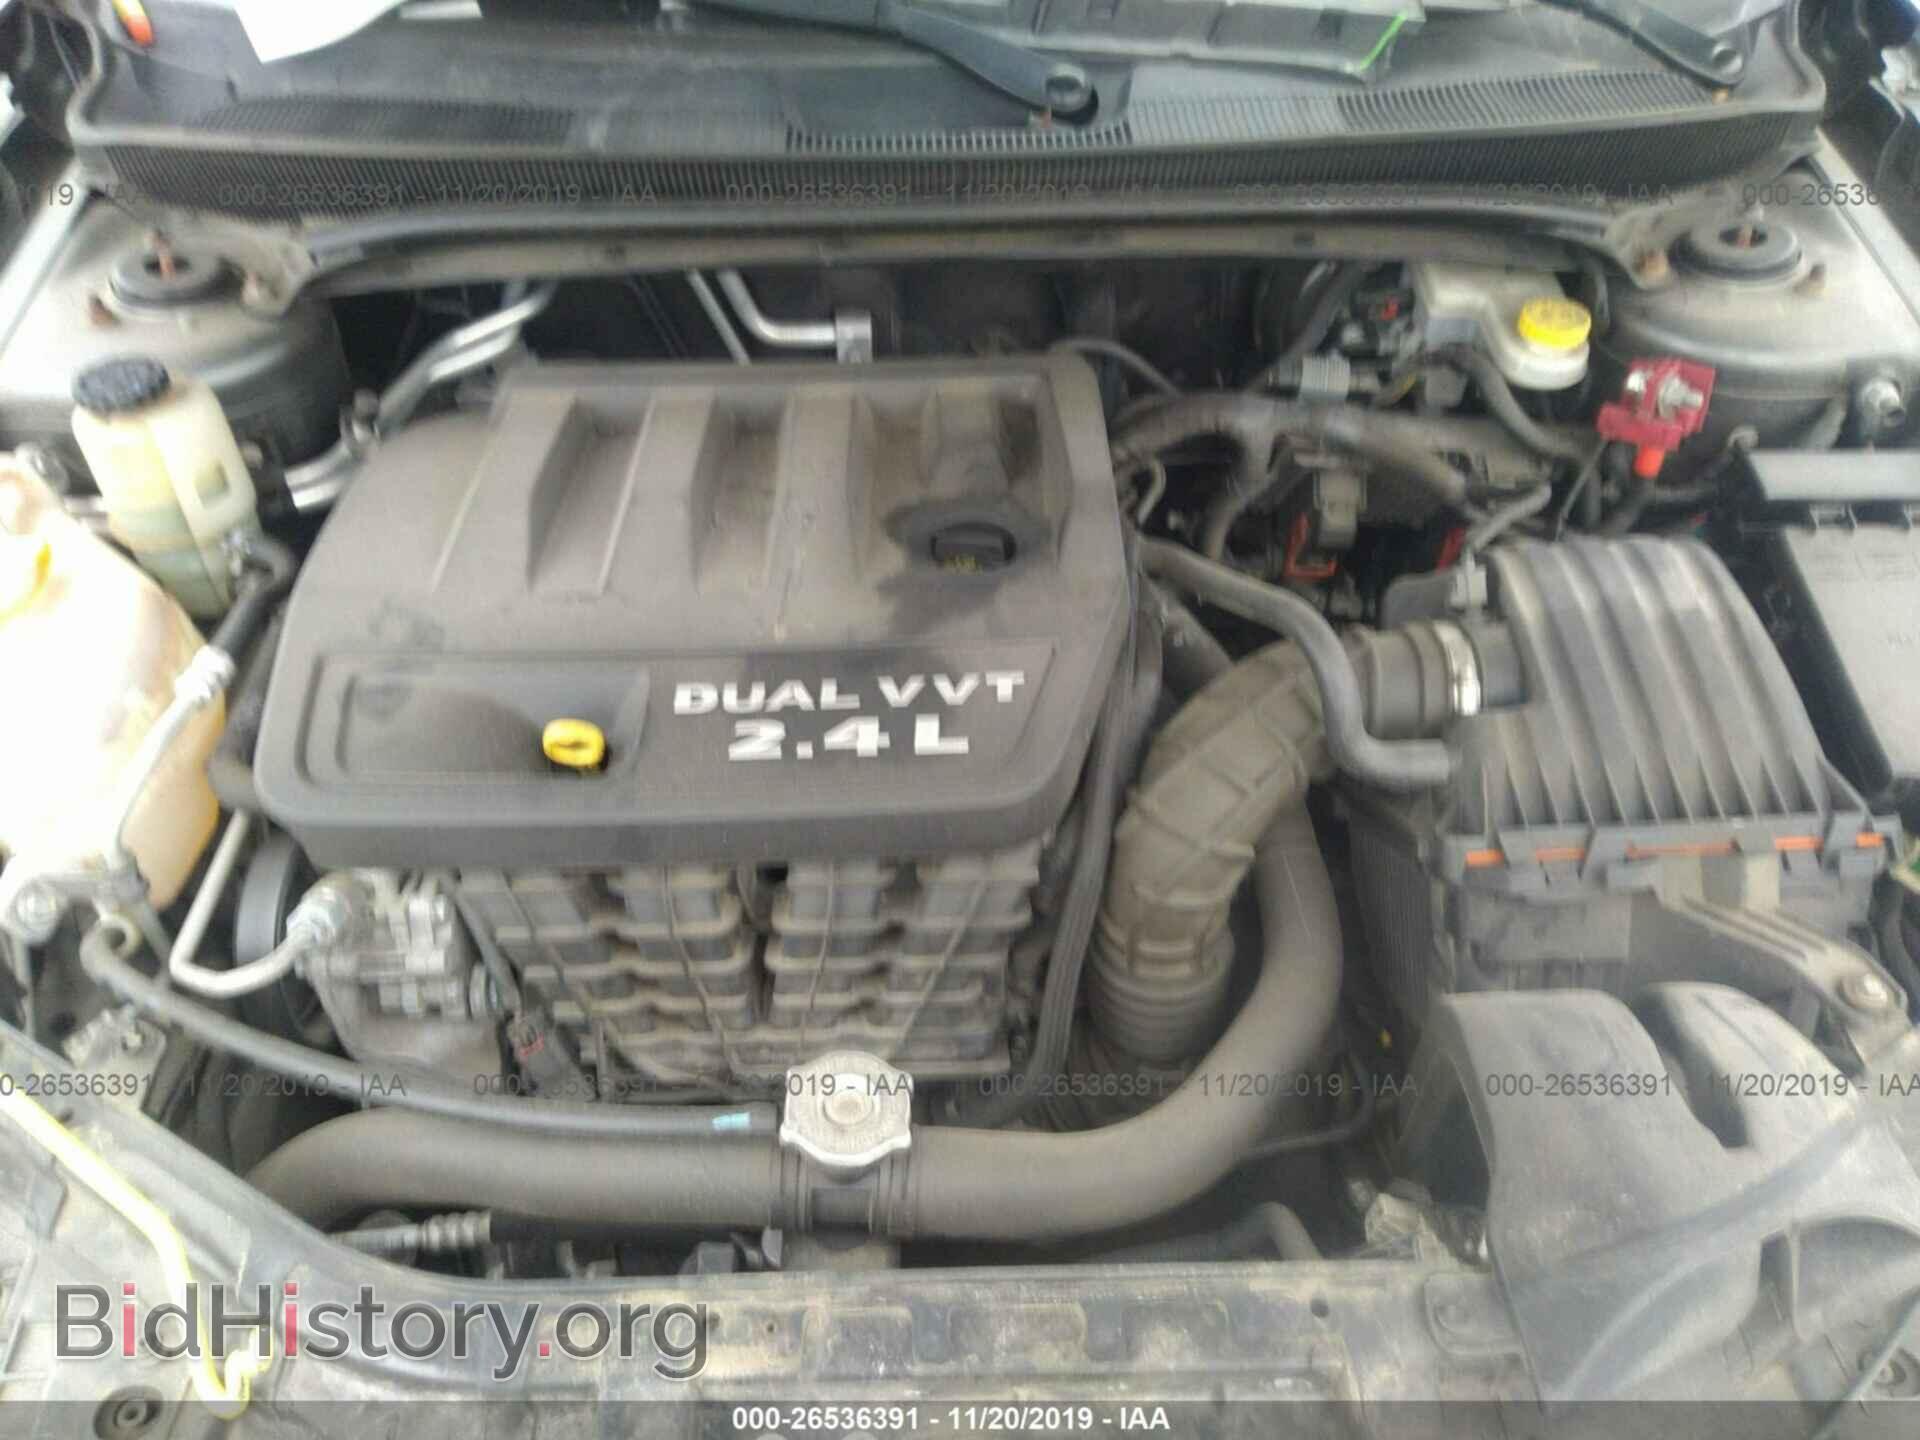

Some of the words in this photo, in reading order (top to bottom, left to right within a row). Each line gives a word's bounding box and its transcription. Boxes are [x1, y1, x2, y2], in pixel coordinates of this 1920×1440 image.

[674, 678, 860, 714] DUAL
[877, 670, 1025, 707] VVT
[728, 715, 891, 761] 2.4
[914, 713, 970, 756] L
